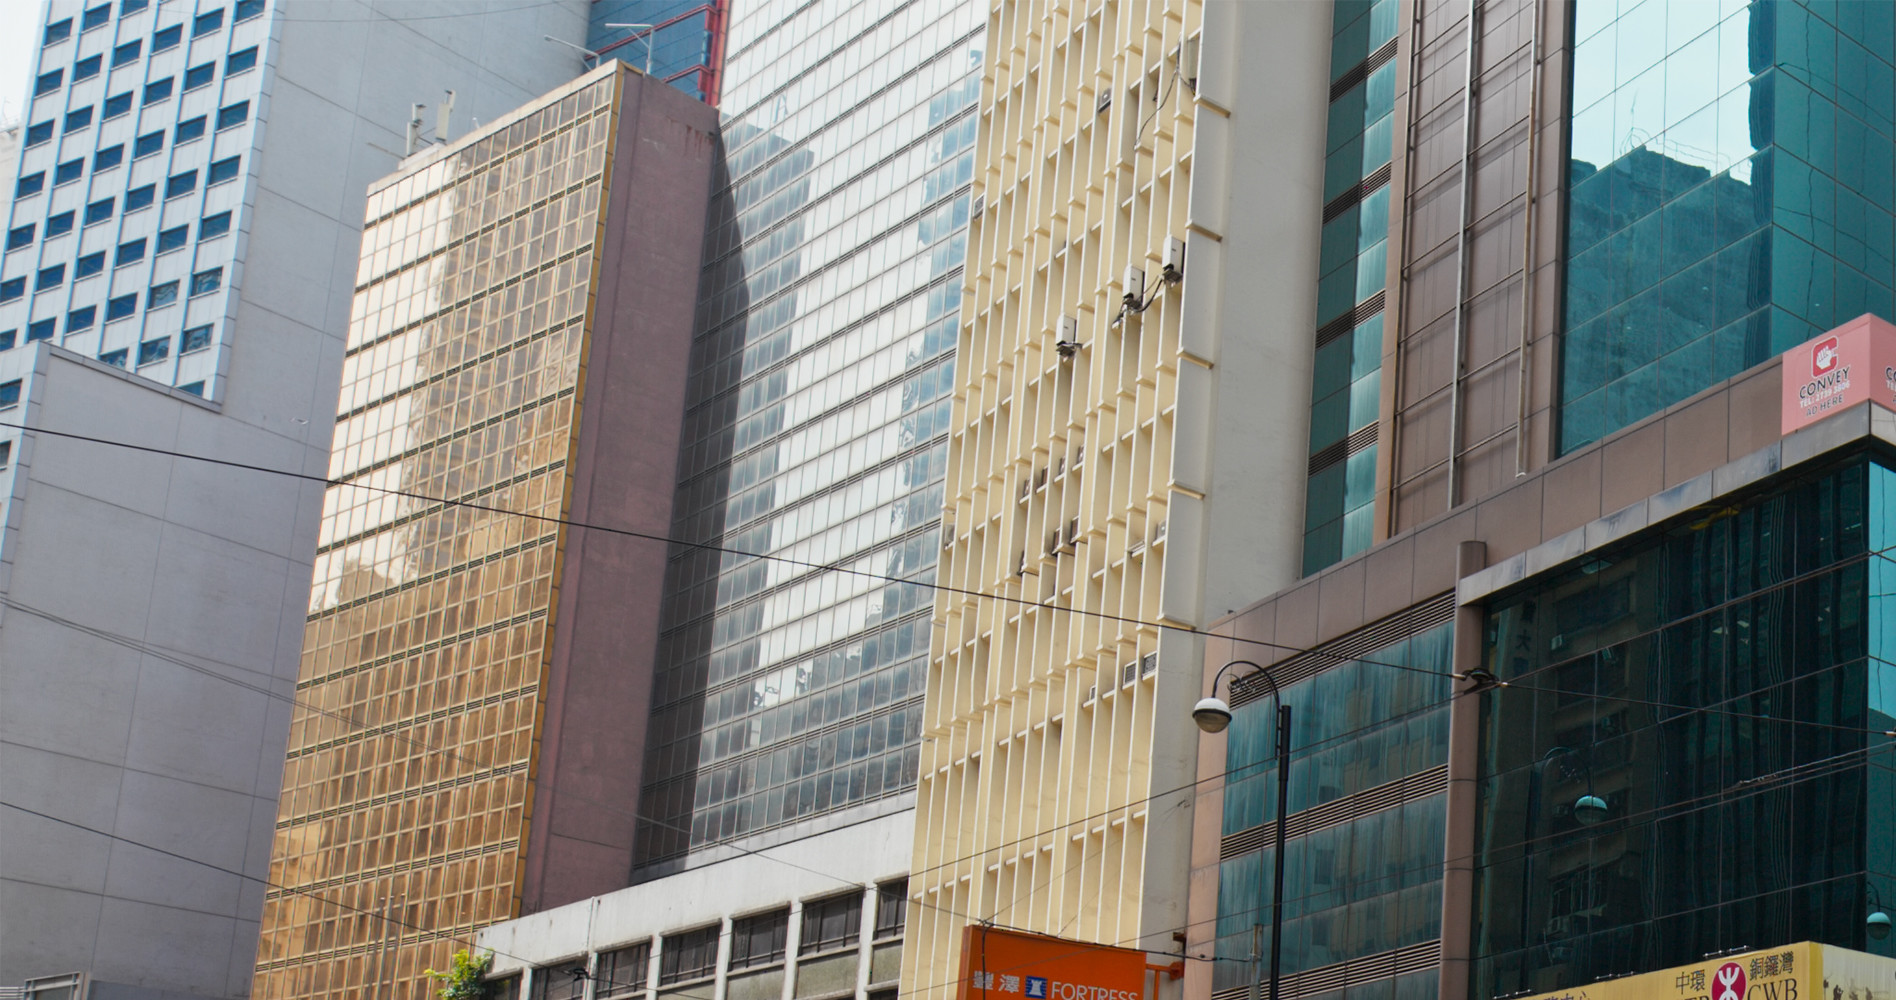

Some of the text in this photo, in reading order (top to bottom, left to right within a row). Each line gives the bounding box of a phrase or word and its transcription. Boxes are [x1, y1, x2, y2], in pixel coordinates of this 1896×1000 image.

[1799, 366, 1850, 399] CONVEY
[1820, 394, 1843, 411] HERE
[1750, 950, 1794, 981] 銅鑼灣
[1676, 969, 1705, 995] 中環
